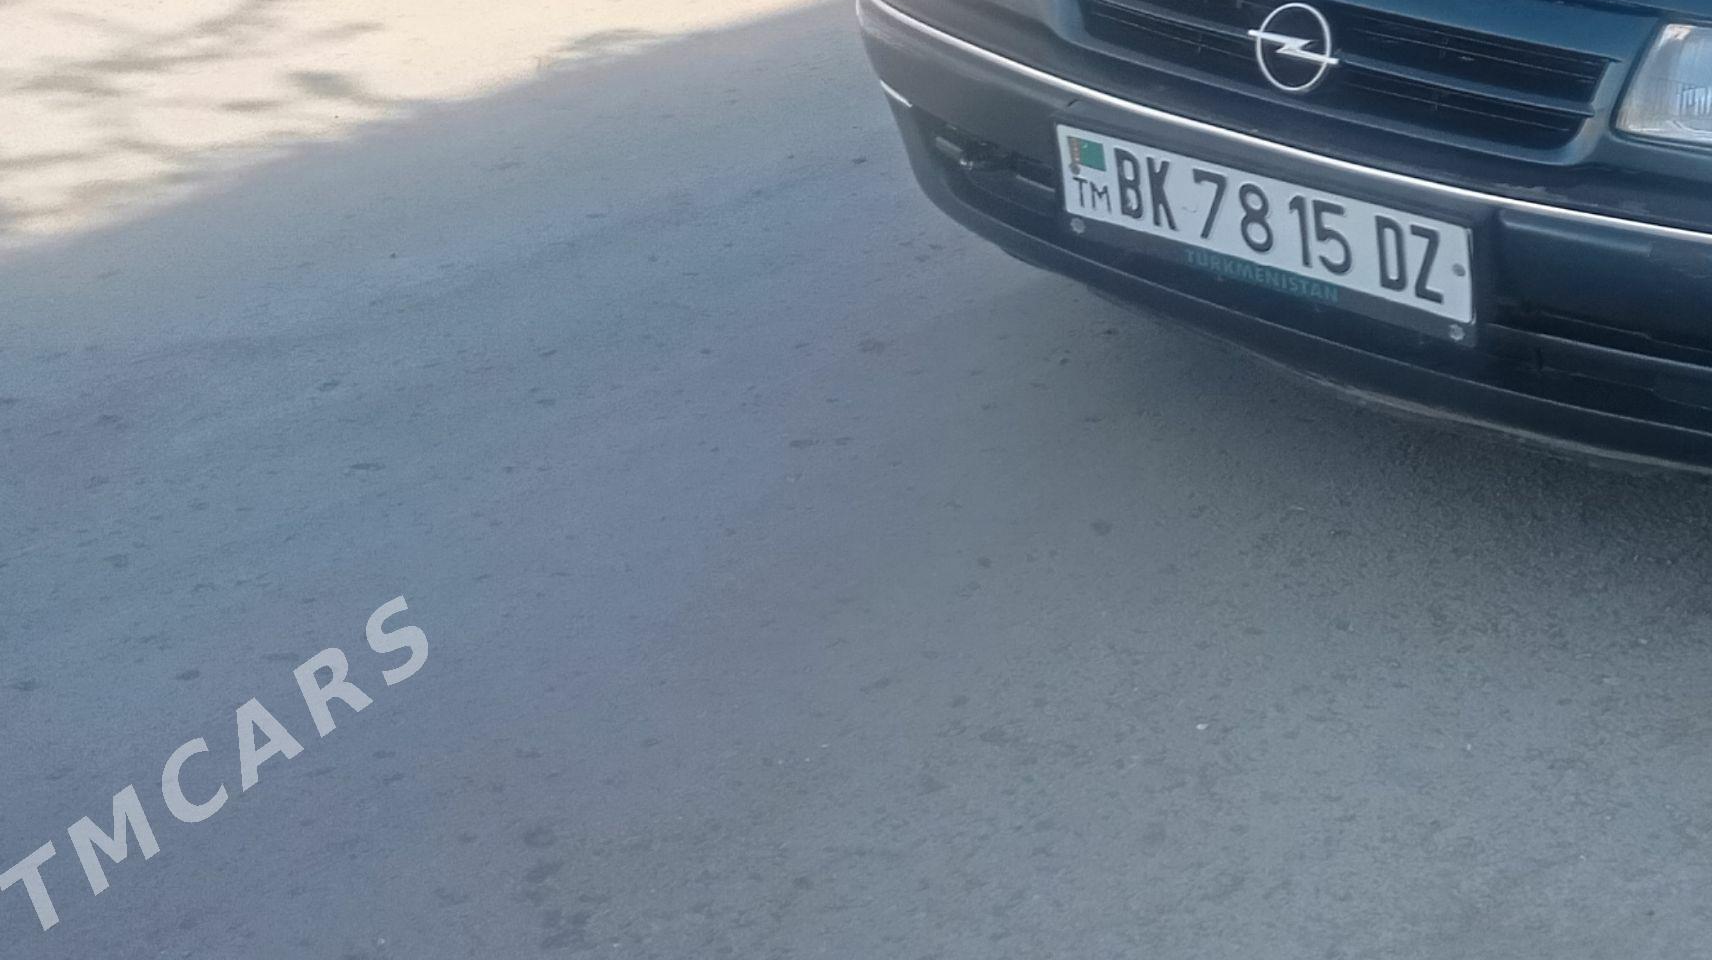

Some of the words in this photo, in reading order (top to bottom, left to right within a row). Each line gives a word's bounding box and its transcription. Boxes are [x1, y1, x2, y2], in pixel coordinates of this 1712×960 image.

[1072, 176, 1112, 213] TM
[1114, 148, 1177, 231] BK
[1192, 169, 1352, 275] 7815
[1375, 215, 1444, 305] DZ
